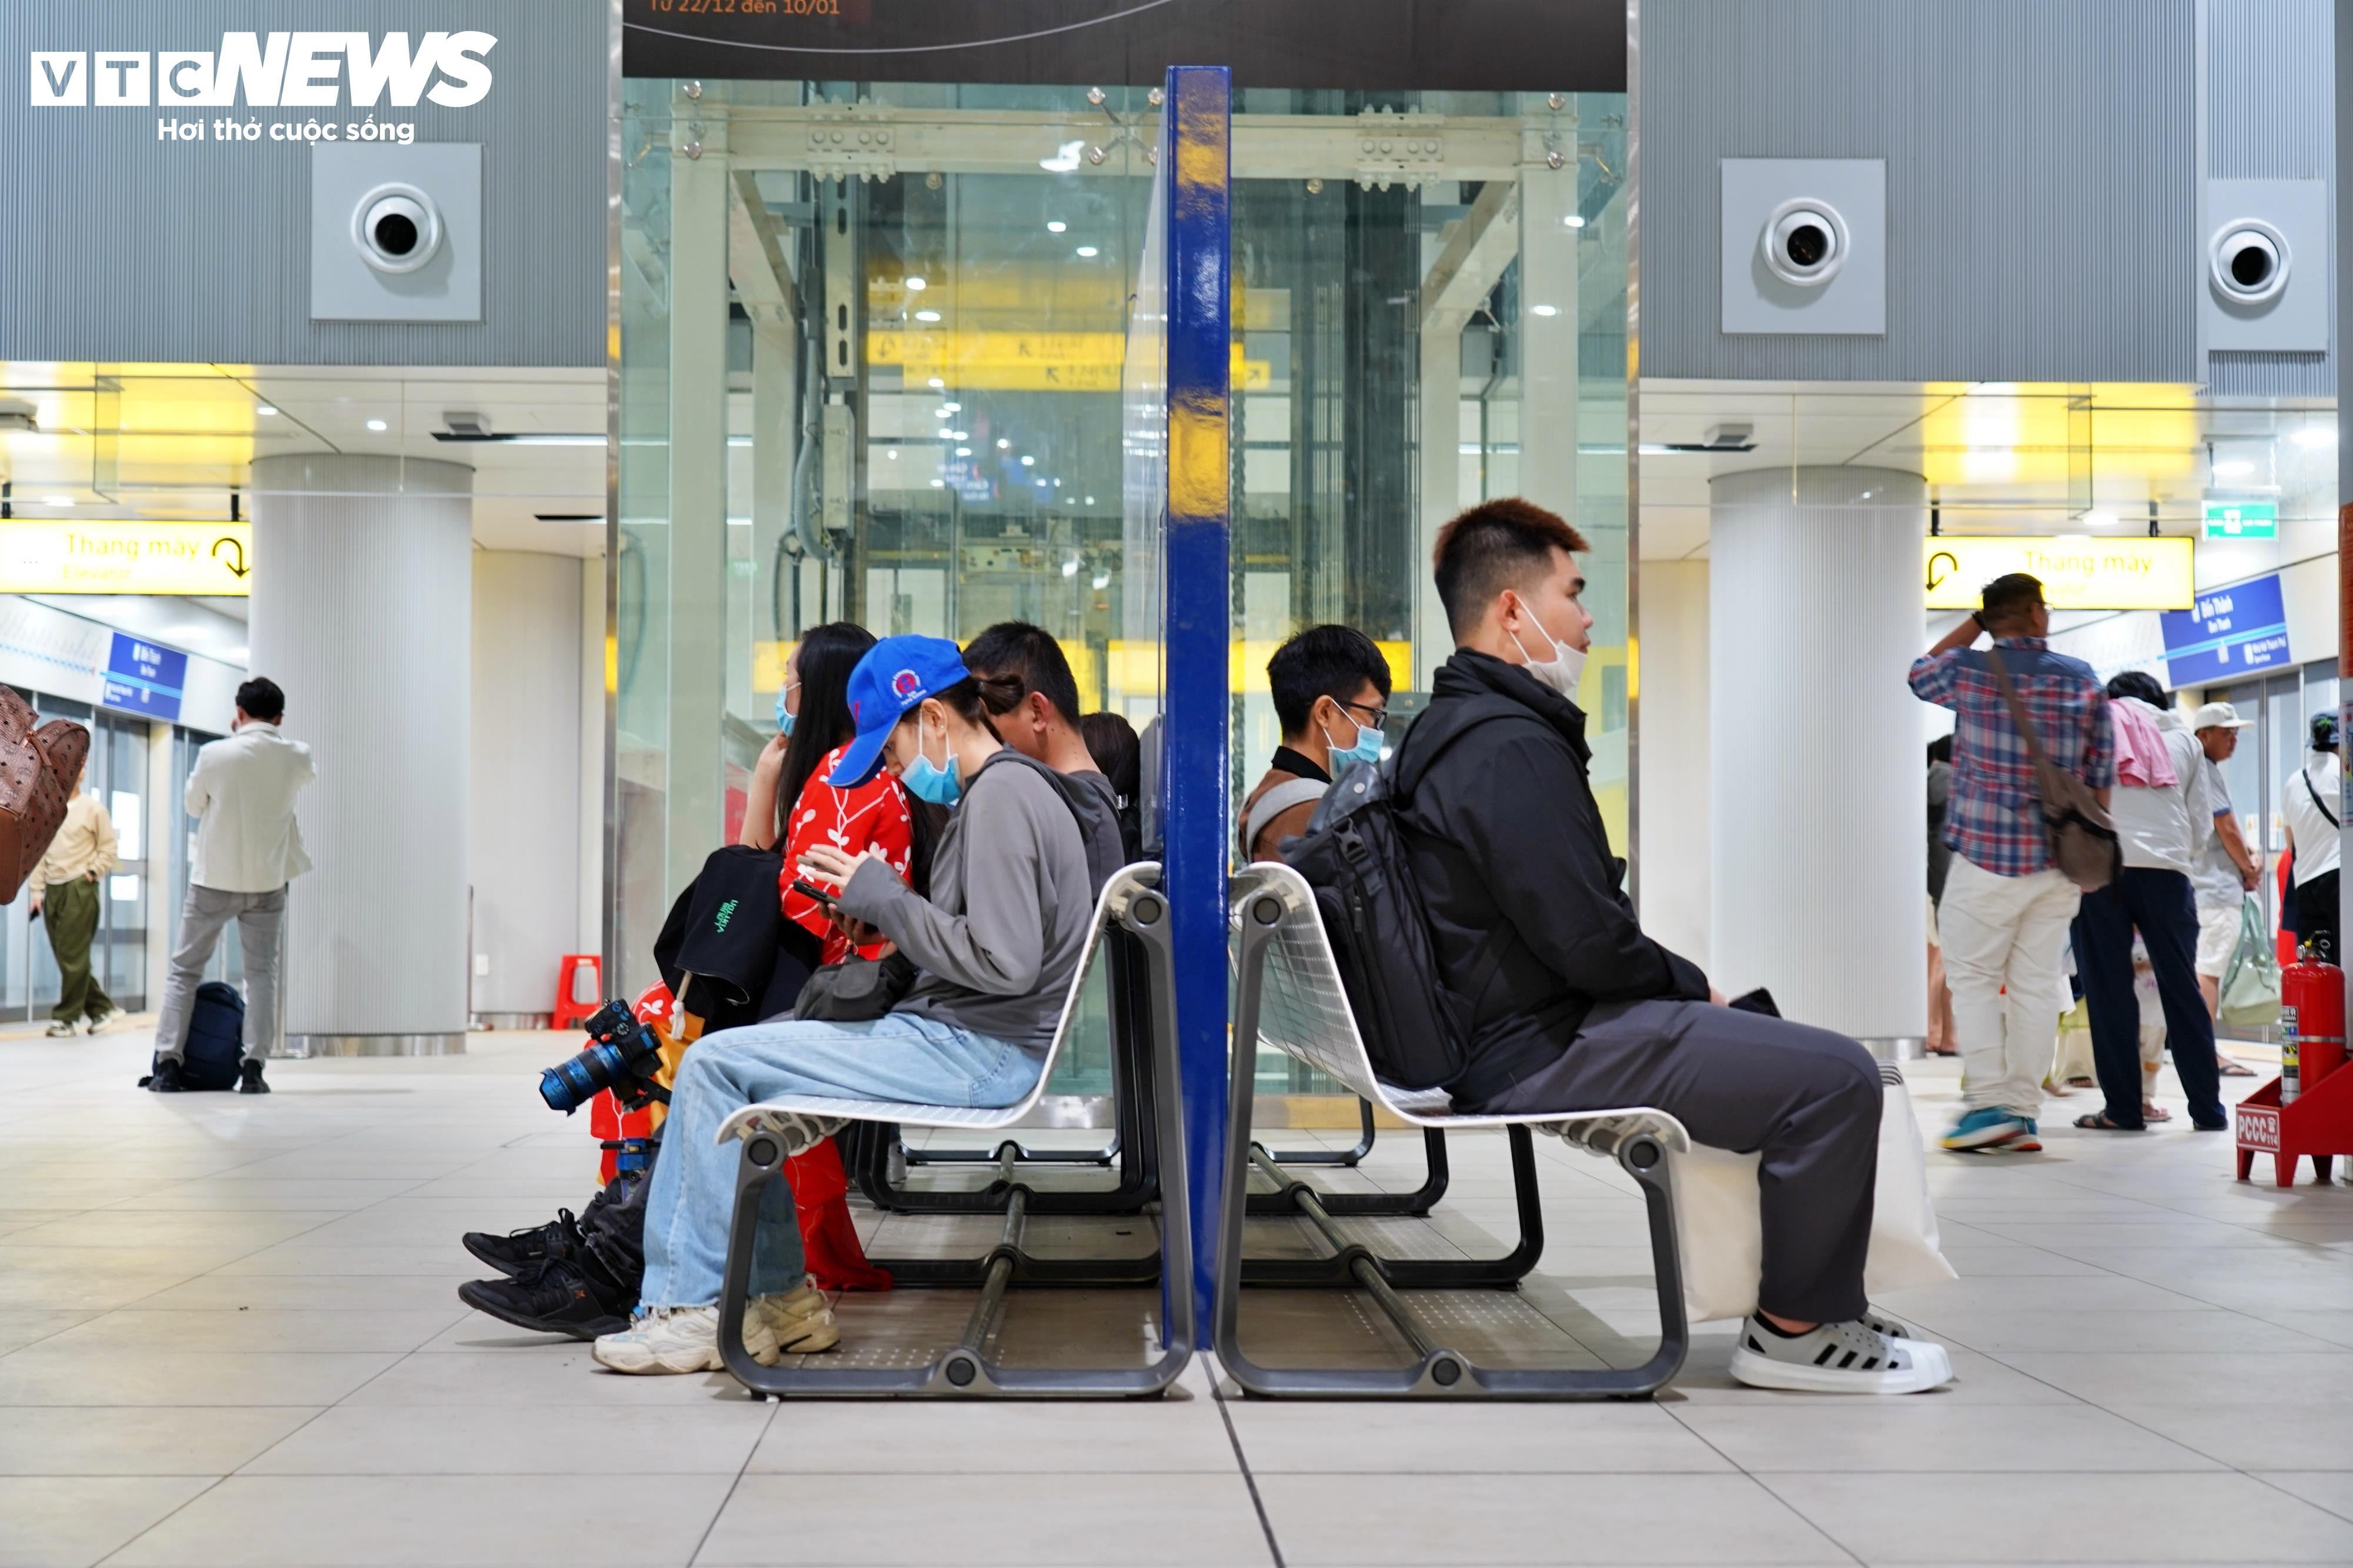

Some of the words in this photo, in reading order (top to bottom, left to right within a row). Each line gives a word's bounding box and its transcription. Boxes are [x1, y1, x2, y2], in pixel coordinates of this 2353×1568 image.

[678, 0, 735, 13] 22/12
[783, 0, 840, 15] 10/01
[67, 533, 139, 561] Thang
[2024, 550, 2095, 577] Thang
[2238, 1114, 2267, 1143] PCCC
